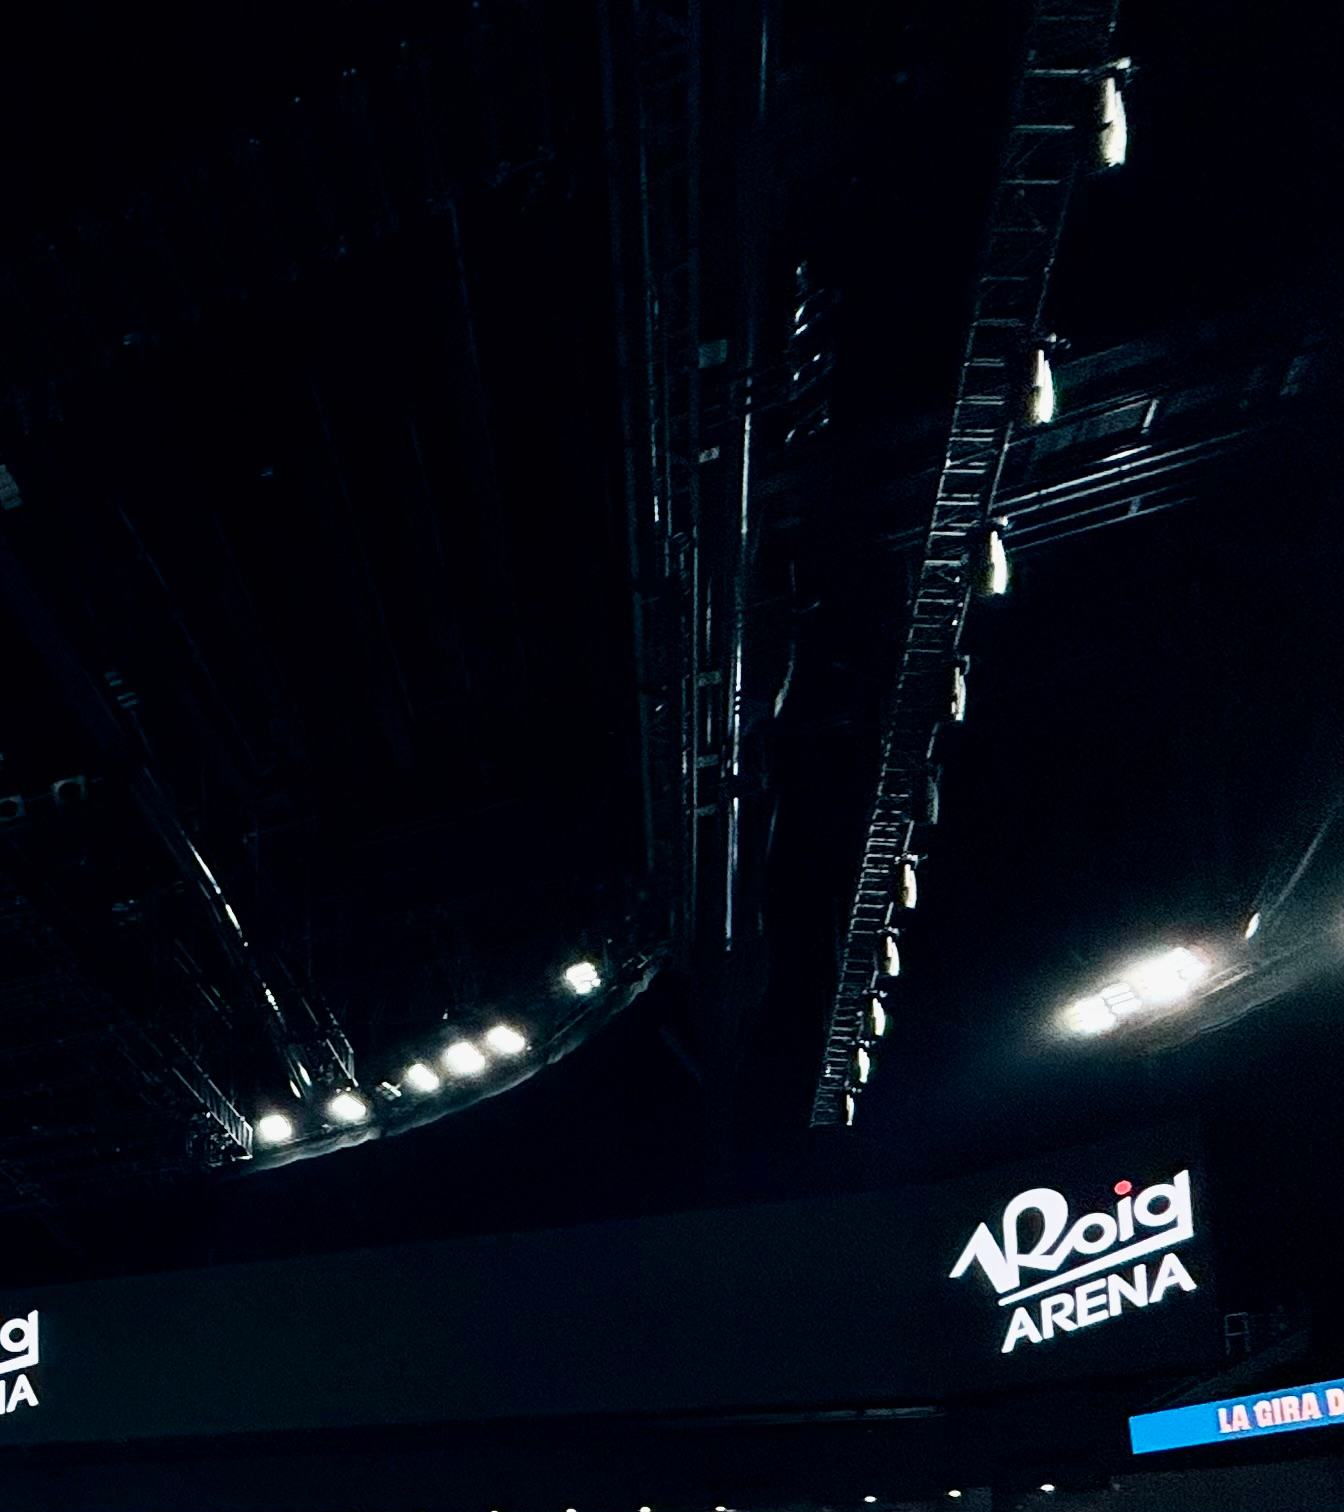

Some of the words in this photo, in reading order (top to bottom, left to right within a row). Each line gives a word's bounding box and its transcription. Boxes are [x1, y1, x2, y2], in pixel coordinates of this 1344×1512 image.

[948, 1169, 1194, 1306] Roig
[1001, 1252, 1197, 1354] ARENA
[1217, 1403, 1251, 1433] LA
[1253, 1391, 1322, 1430] GIRA
